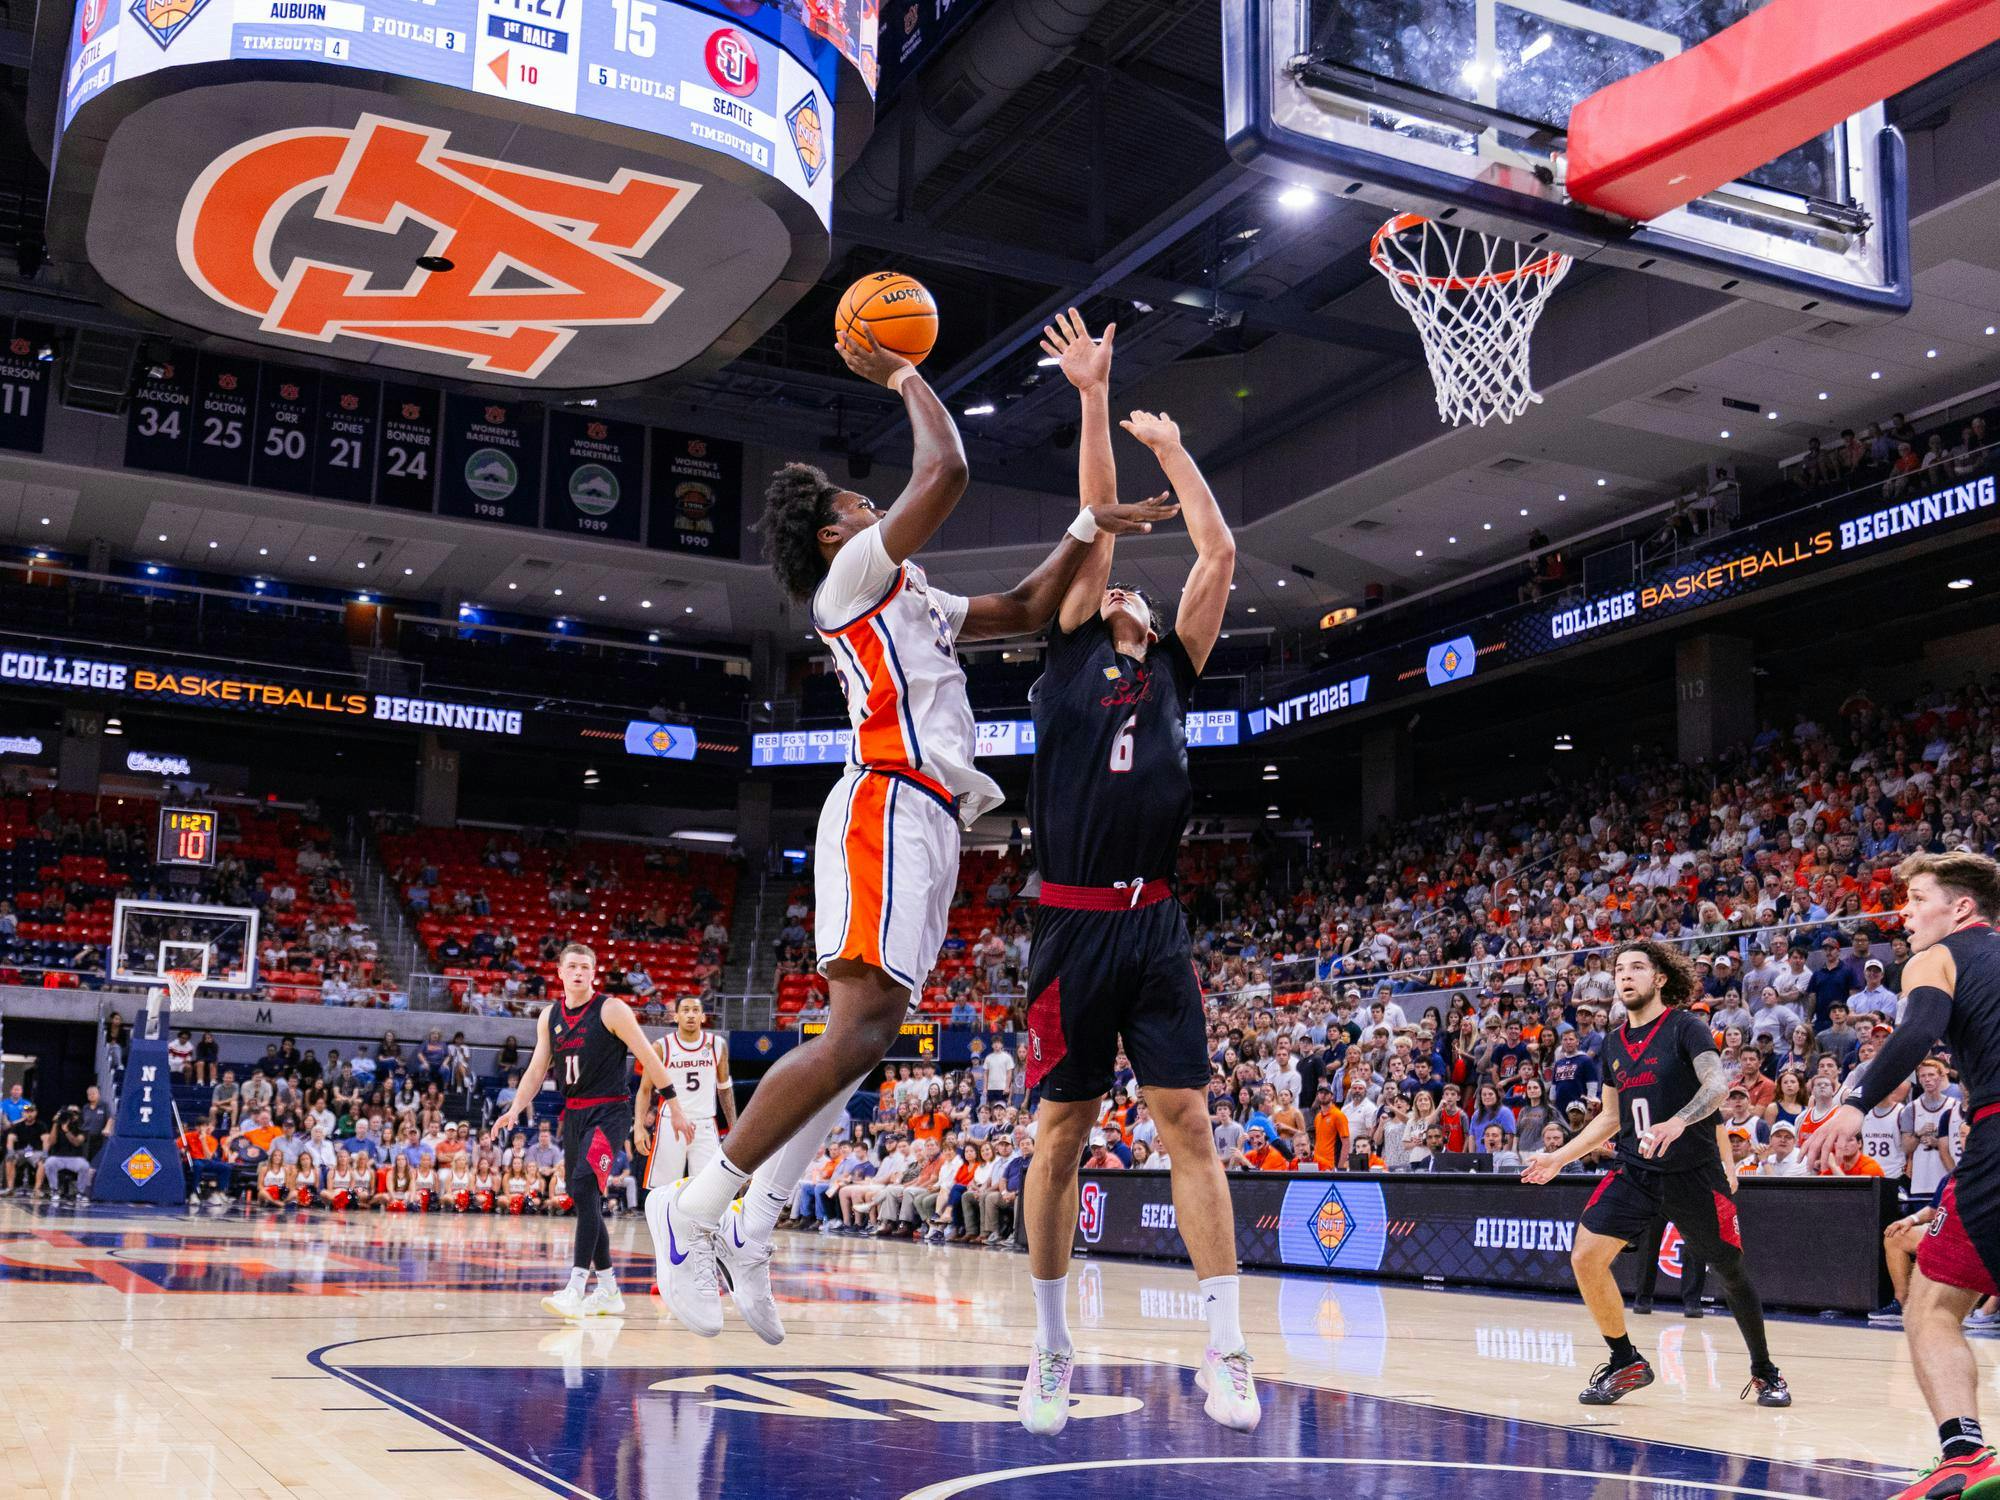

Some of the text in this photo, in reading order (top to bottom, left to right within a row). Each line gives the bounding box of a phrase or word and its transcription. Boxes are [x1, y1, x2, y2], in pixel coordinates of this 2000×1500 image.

[270, 2, 326, 21] AUBURN
[372, 16, 455, 50] FOULS 3
[503, 21, 556, 49] 1ST HALF
[611, 0, 657, 58] 15
[242, 36, 341, 57] TIMEOUTS 4
[520, 64, 538, 85] 10
[599, 68, 675, 101] 5 FOULS
[713, 97, 753, 127] SEATTLE
[690, 122, 752, 153] TIMEOUTS
[2, 383, 30, 417] 11
[136, 388, 190, 406] JACKSON
[204, 400, 247, 416] BOLTON
[275, 411, 298, 424] ORR
[137, 406, 181, 440] 34
[330, 421, 364, 435] JONES
[471, 423, 518, 438] WOMEN'S
[202, 417, 243, 449] 25
[386, 430, 432, 446] BONNER
[466, 432, 521, 448] BASKETBALL
[264, 427, 306, 460] 50
[329, 437, 361, 469] 21
[574, 439, 619, 453] WOMEN'S
[386, 447, 428, 480] 24
[569, 448, 623, 463] BASKETBALL
[675, 457, 719, 470] WOMEN'S
[671, 466, 721, 480] BASKETBALL
[474, 504, 505, 517] 1988
[578, 518, 609, 532] 1989
[680, 534, 709, 548] 1990
[1552, 475, 1996, 639] COLLEGE BASKETBALL'S BEGINNING
[1, 651, 523, 736] COLLEGE BASKETBALL'S BEGINNING
[1681, 679, 1704, 701] 113
[1209, 714, 1232, 724] REB
[758, 736, 778, 746] REB
[814, 734, 829, 743] TO
[1109, 713, 1137, 773] 6
[1216, 727, 1225, 743] 4
[763, 747, 773, 763] 10
[783, 746, 805, 761] 40.0
[818, 745, 825, 760] 2
[979, 741, 993, 754] 10
[171, 813, 211, 832] 11:27
[179, 831, 205, 860] 10
[256, 1008, 273, 1024] M
[899, 1023, 934, 1036] SEATTLE
[919, 1037, 935, 1054] 15
[565, 1055, 580, 1085] 11
[668, 1059, 714, 1069] AUBURN
[686, 1071, 701, 1092] 5
[1631, 1097, 1652, 1139] 0
[1867, 1141, 1890, 1157] 38
[1140, 1203, 1177, 1229] SEAT
[1318, 1219, 1344, 1232] NIT
[1473, 1217, 1575, 1252] AUBURN
